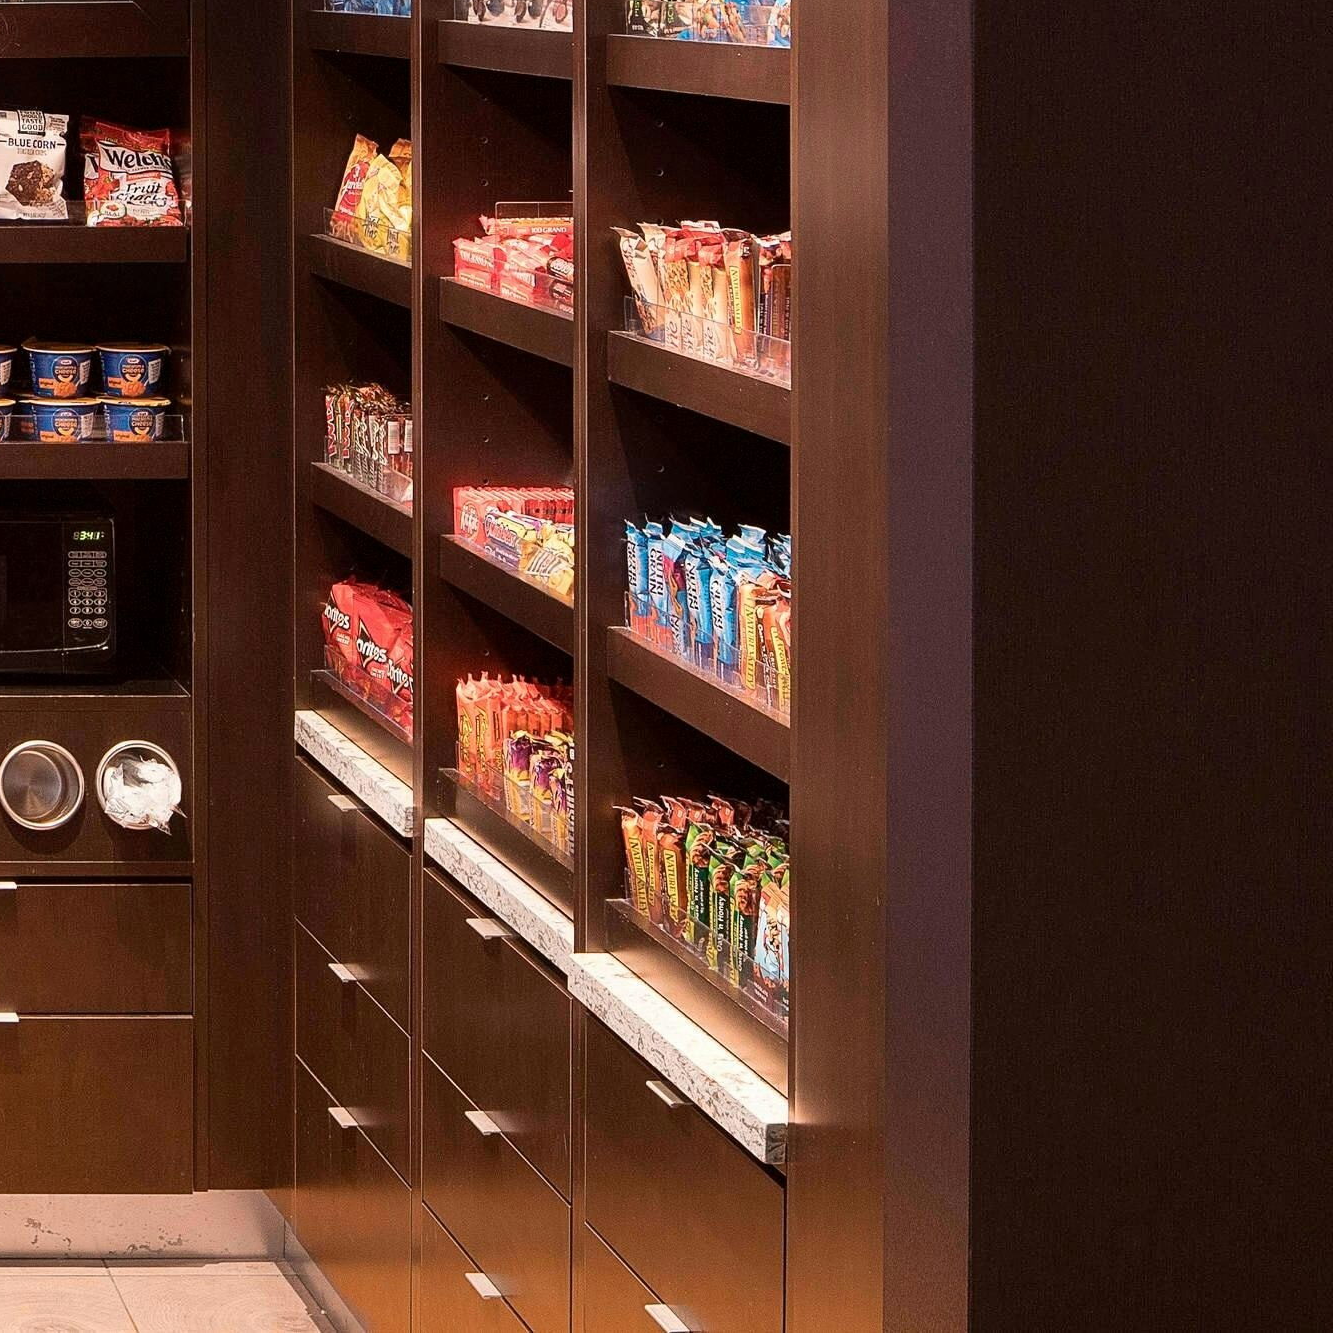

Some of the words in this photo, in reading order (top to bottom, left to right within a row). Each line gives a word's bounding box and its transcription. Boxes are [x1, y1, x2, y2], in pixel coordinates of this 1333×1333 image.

[8, 137, 31, 148] BLUE
[32, 138, 56, 149] CORN
[21, 124, 44, 132] GOOD
[125, 182, 163, 194] Fruit
[649, 548, 657, 595] GRAIN
[656, 550, 664, 596] NUTRI
[745, 609, 755, 649] NATURE
[630, 840, 643, 879] NATURE
[664, 853, 677, 892] NATURE
[717, 896, 726, 921] Honey
